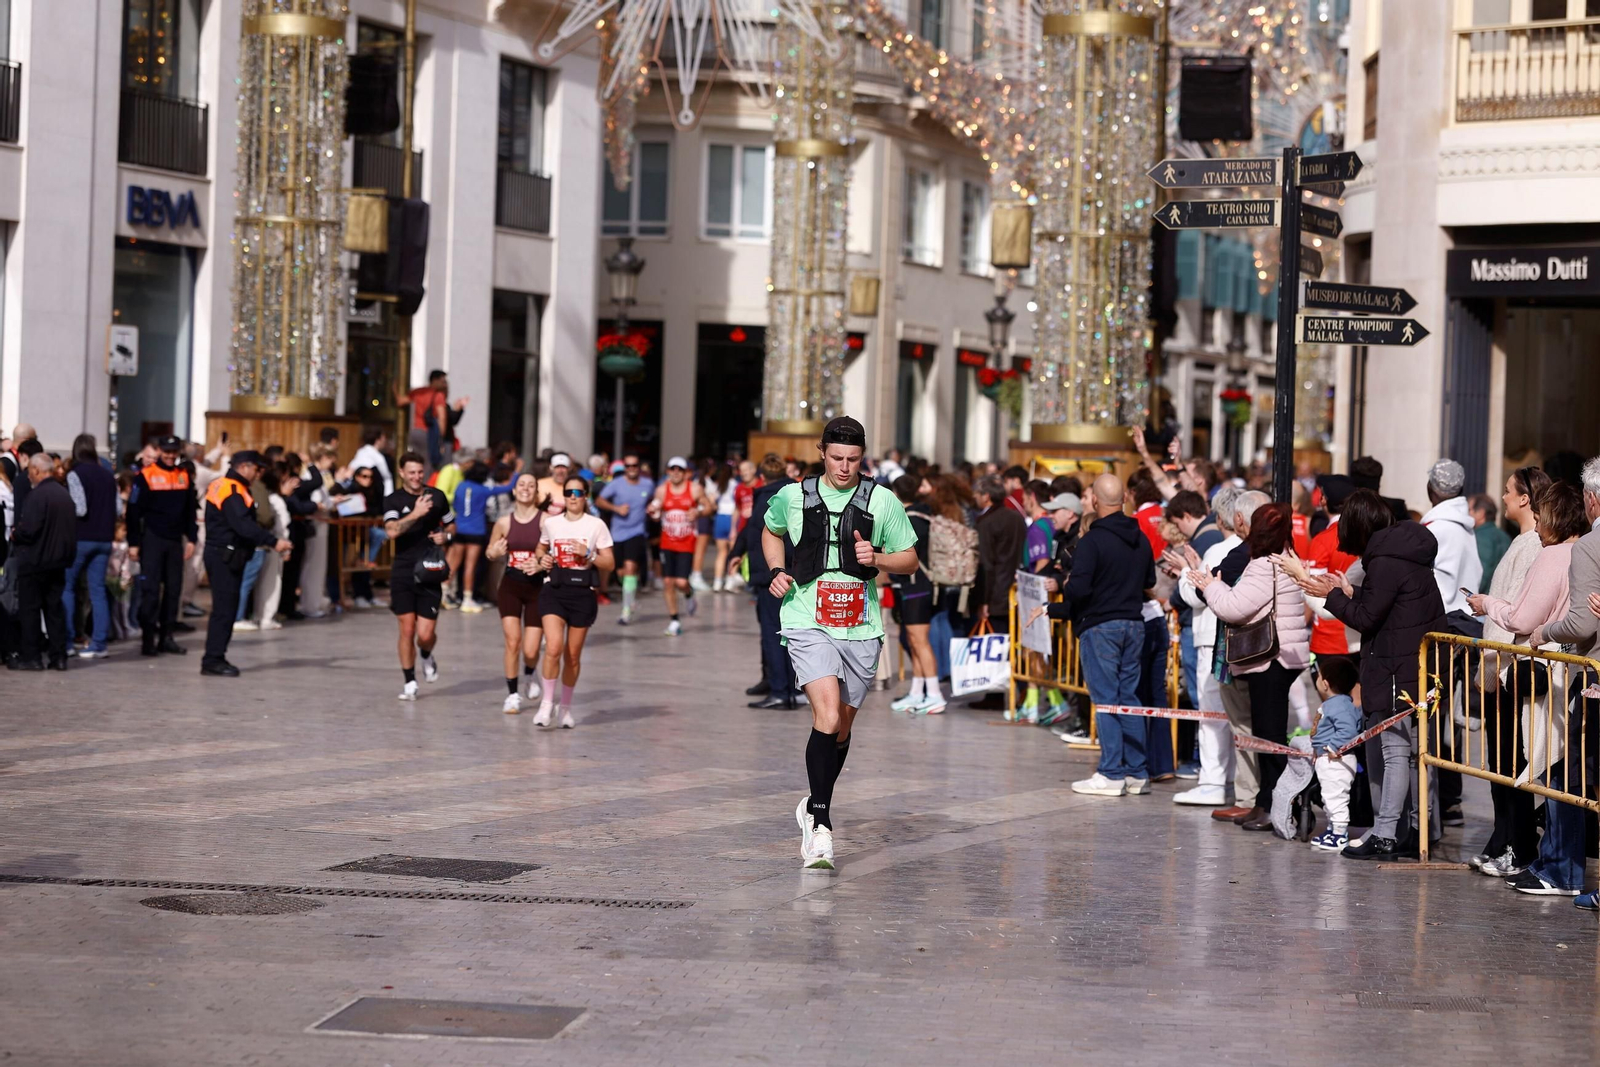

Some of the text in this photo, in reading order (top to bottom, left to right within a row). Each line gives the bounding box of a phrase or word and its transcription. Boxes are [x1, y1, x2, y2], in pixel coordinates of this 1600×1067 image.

[1225, 161, 1271, 170] MERCADO DE
[1202, 171, 1272, 184] ATARAZANAS
[127, 185, 200, 230] BBVA
[1206, 202, 1270, 215] TEATRO SOHO
[1226, 214, 1269, 225] CAIXA BANK
[1471, 256, 1588, 281] Massimo Dutti
[1306, 288, 1389, 308] MUSEO DE MÁLAGA
[1307, 319, 1393, 332] CENTRE POMPIDOU
[1307, 330, 1344, 342] MÁLAGA
[828, 593, 854, 603] 4384
